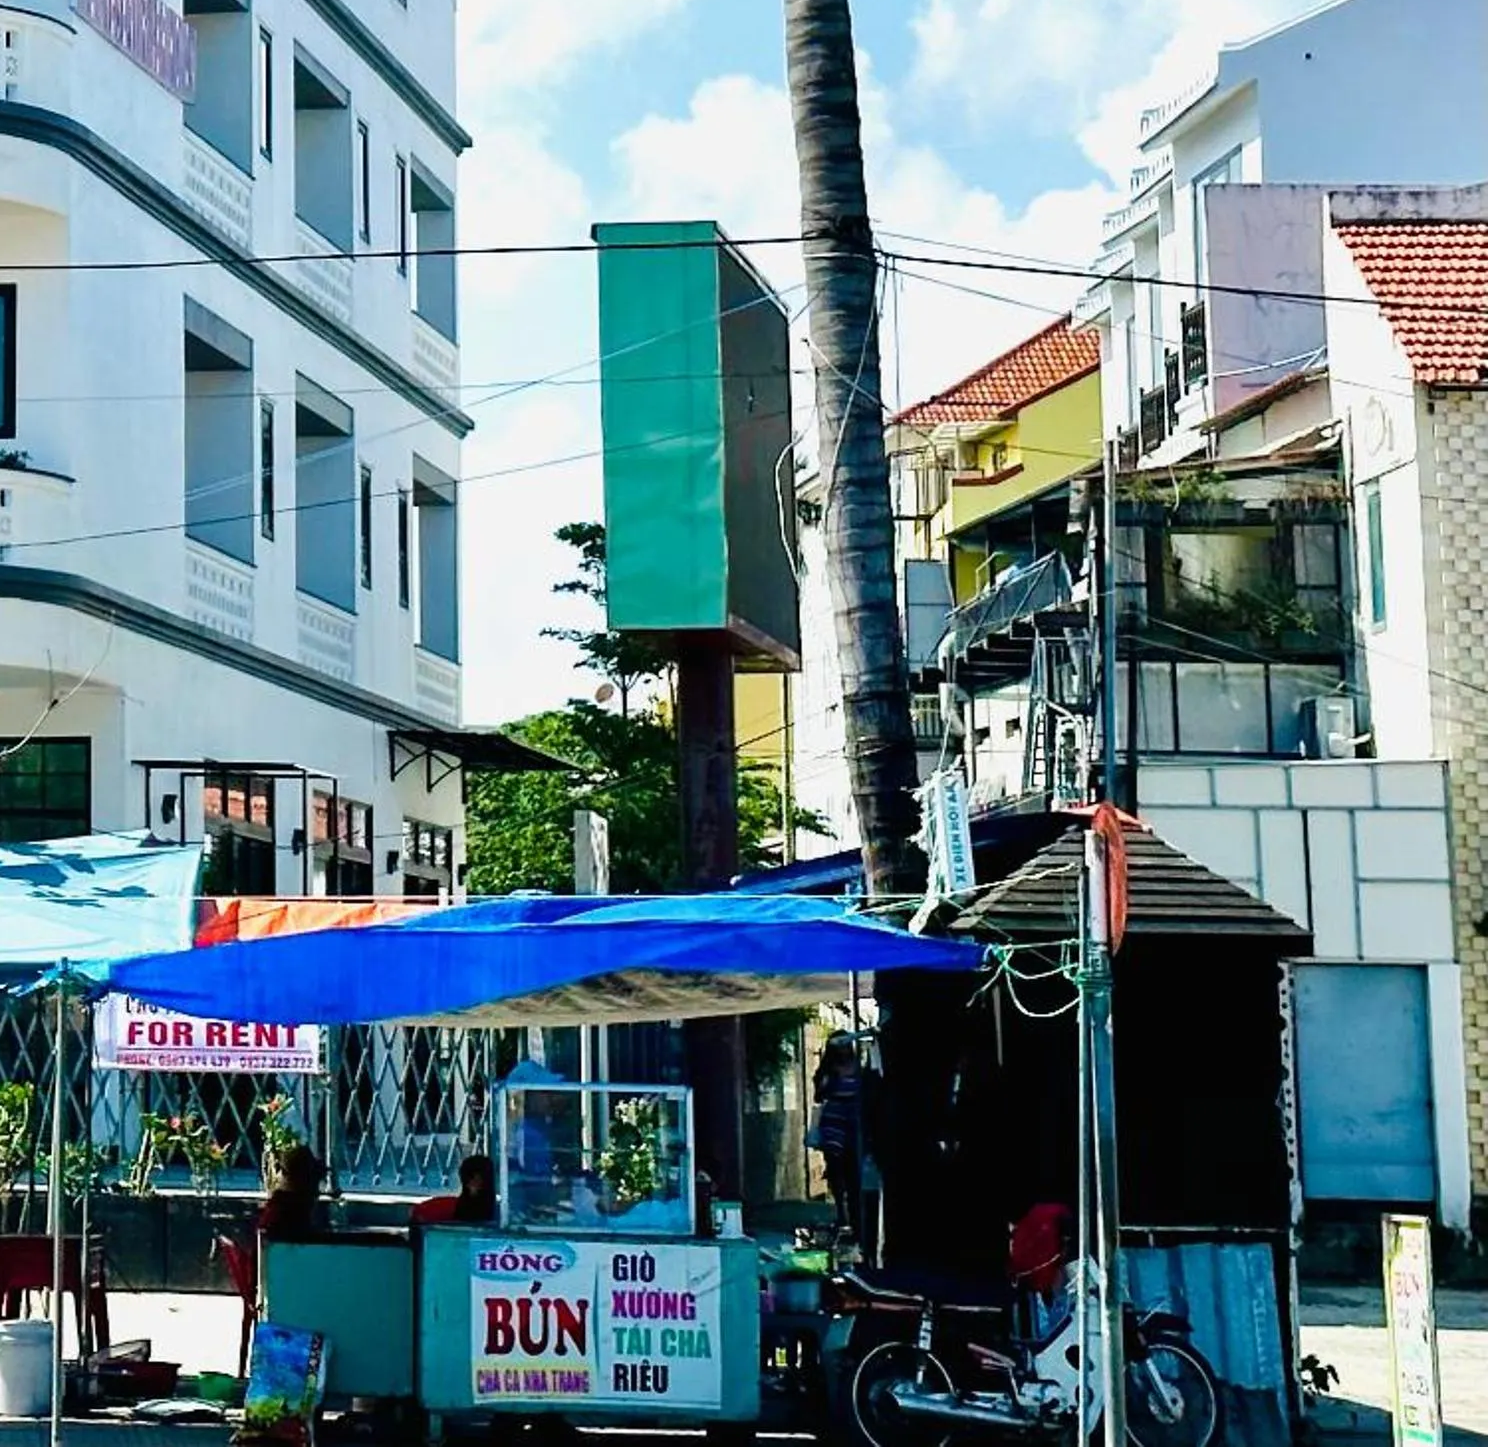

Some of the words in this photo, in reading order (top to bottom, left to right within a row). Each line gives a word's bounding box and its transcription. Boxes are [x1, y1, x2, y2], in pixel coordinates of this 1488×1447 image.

[127, 1021, 194, 1047] FOR
[205, 1021, 301, 1048] RENT
[612, 1250, 656, 1283] GIÒ
[484, 1281, 590, 1357] BÚN
[611, 1287, 697, 1321] XƯƠNG
[613, 1359, 670, 1394] RIÊU
